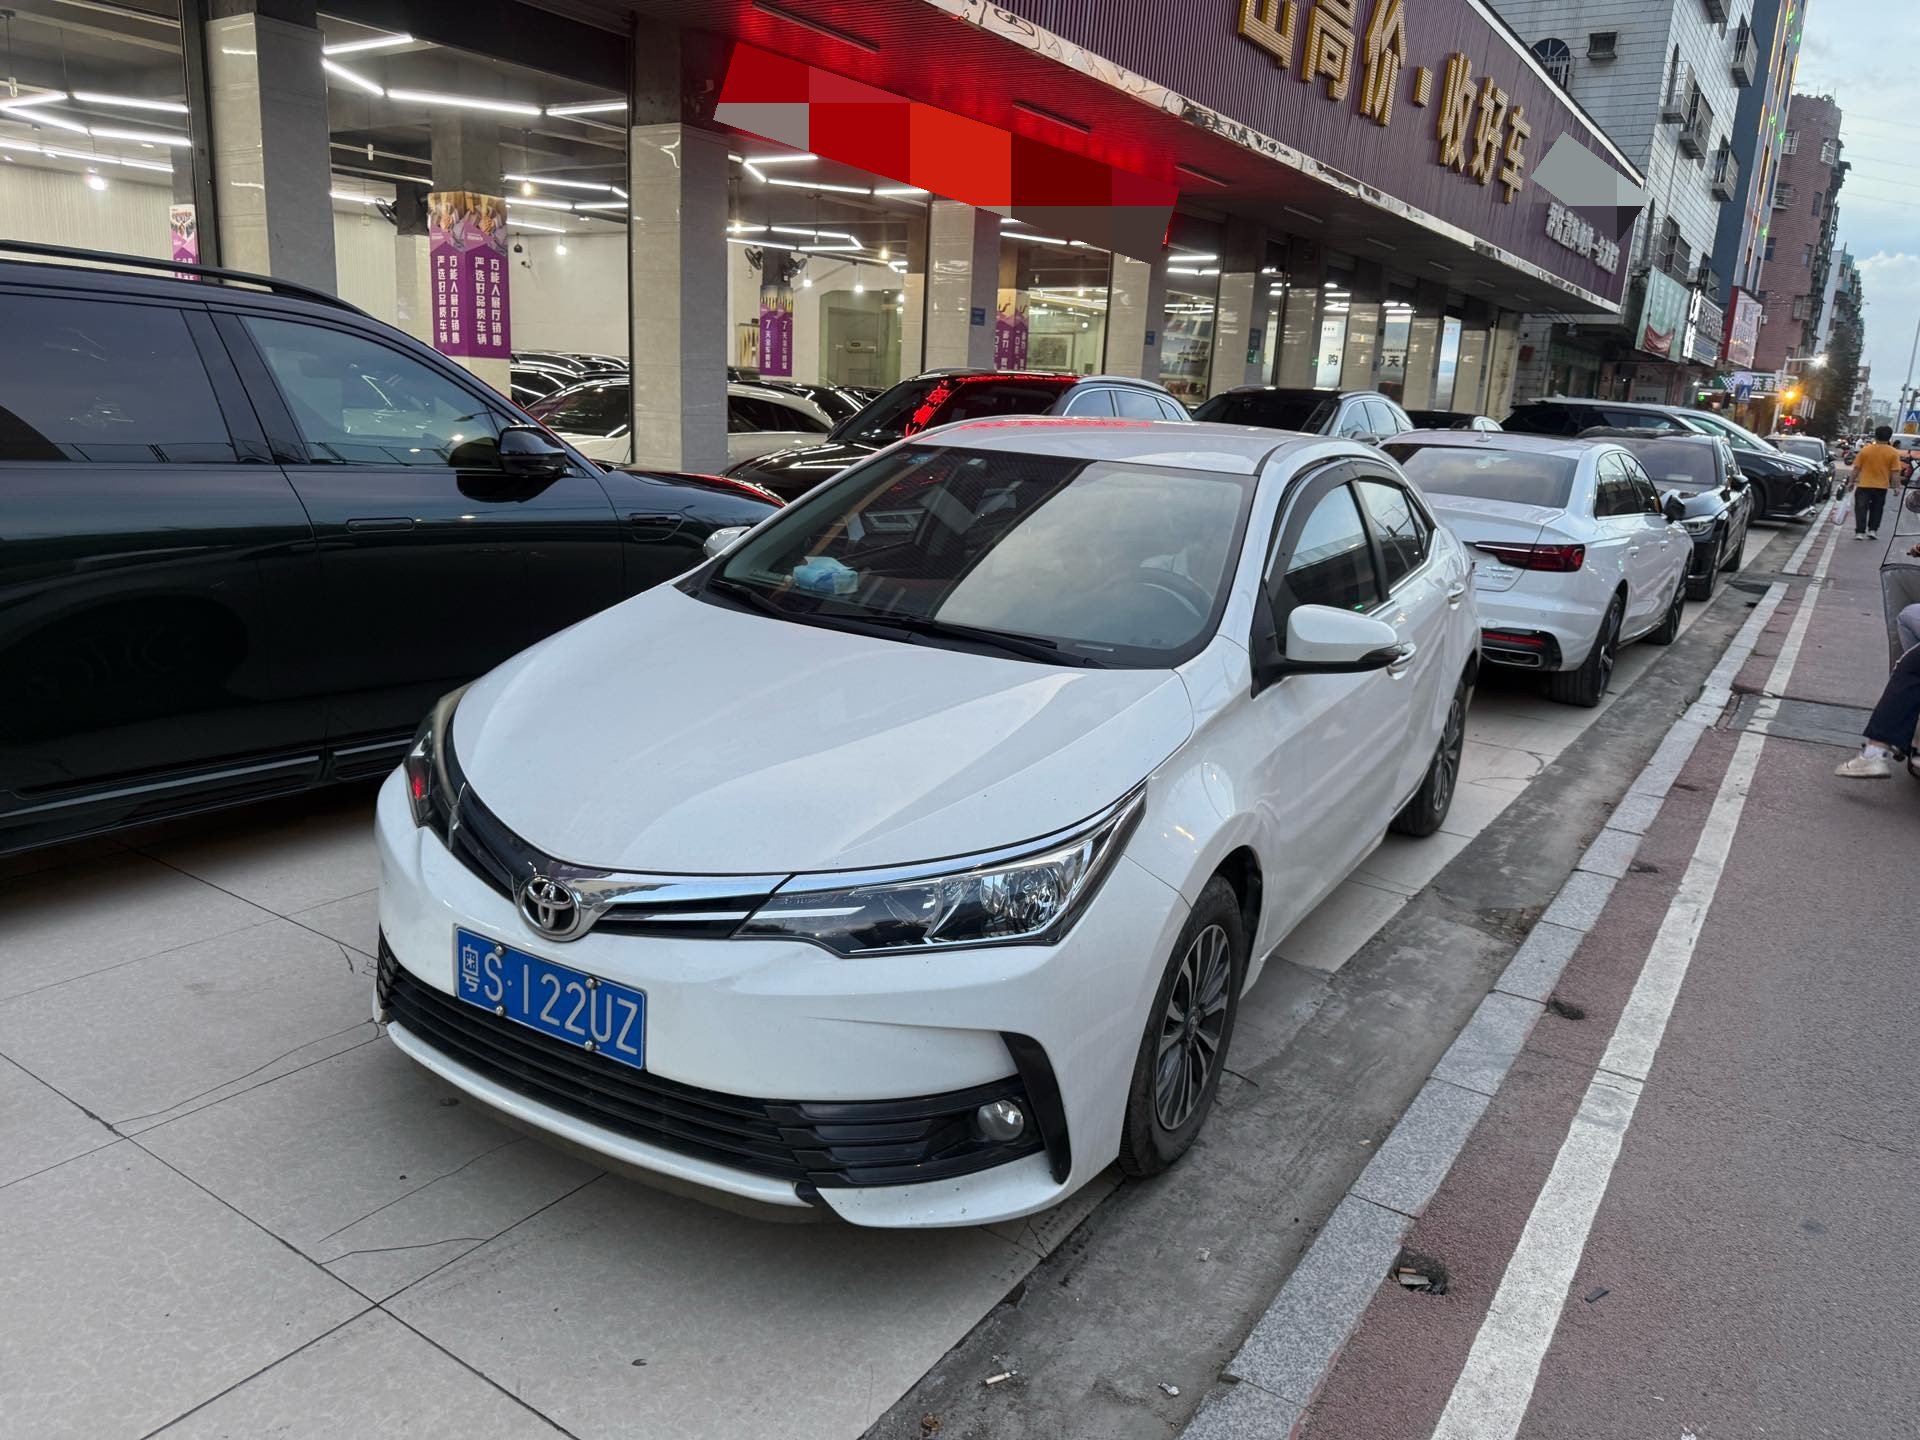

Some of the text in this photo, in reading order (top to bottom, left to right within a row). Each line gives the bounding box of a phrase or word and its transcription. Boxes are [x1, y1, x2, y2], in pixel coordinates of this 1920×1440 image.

[437, 255, 448, 343] 严选好品质车辆
[474, 256, 487, 345] 严选好品质车辆
[462, 943, 638, 1055] 粤S·122UZ
